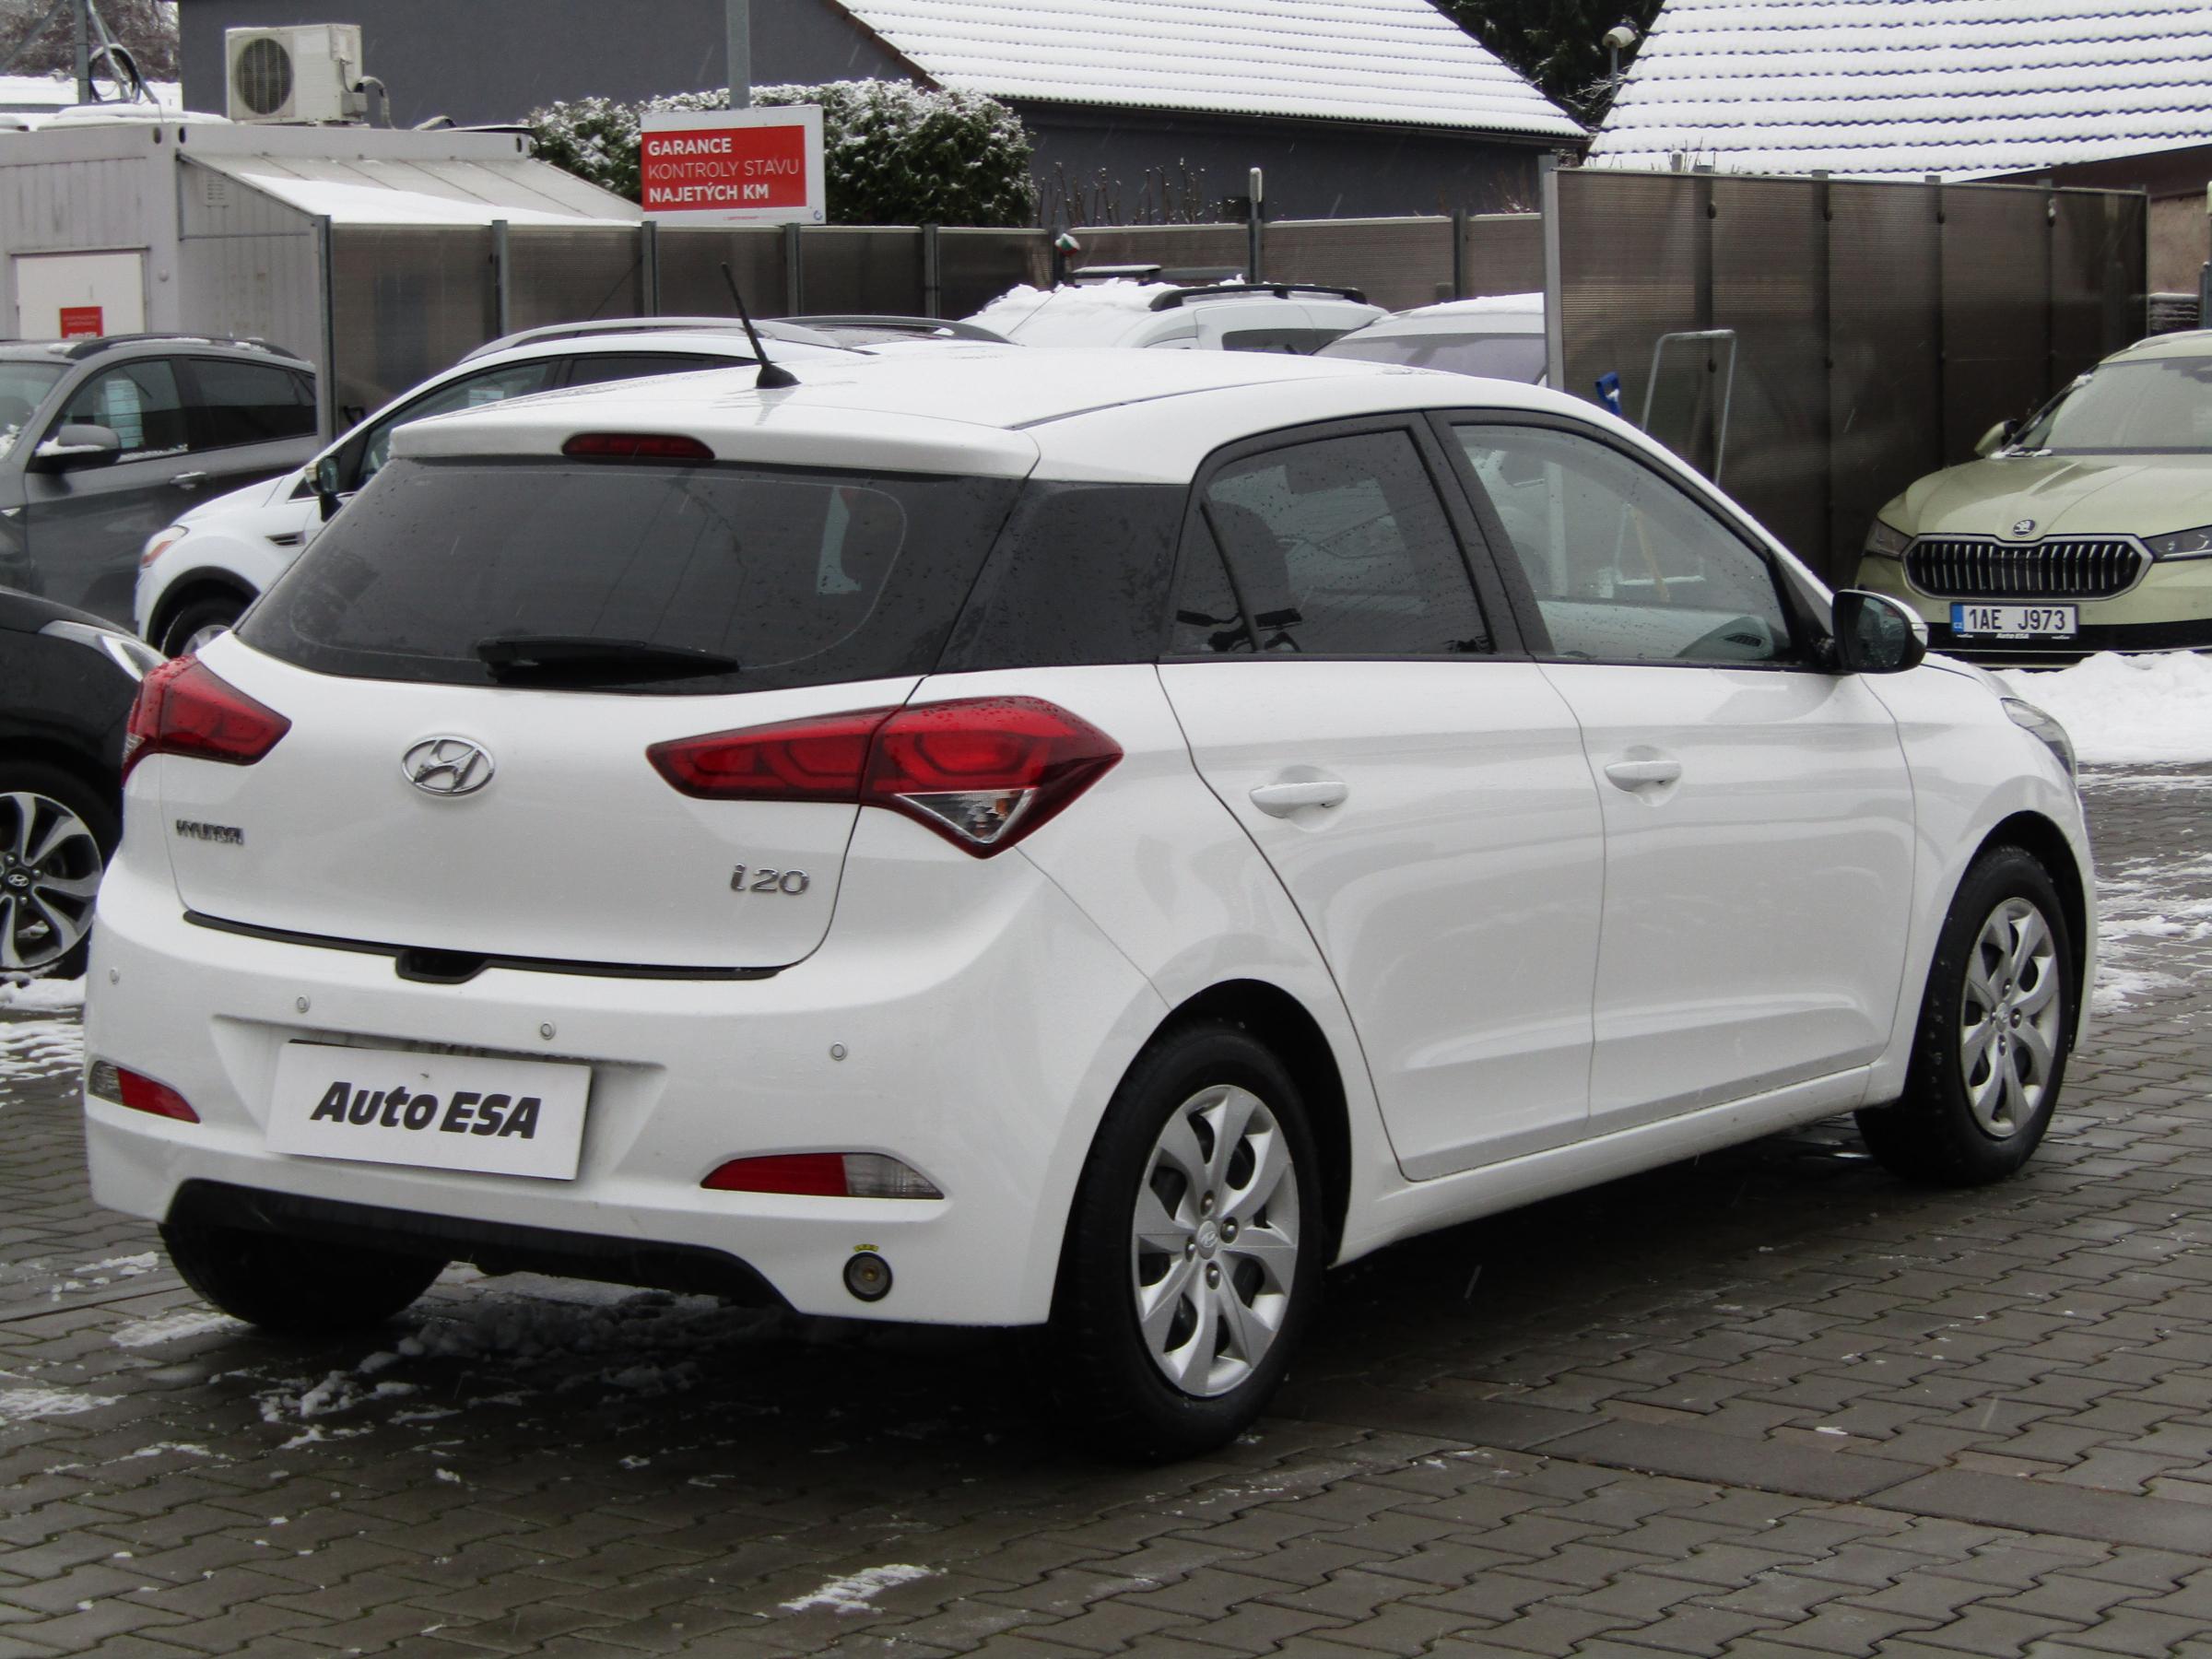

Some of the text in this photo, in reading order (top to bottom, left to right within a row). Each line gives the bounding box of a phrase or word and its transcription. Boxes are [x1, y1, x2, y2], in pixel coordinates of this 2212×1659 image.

[648, 137, 733, 157] GARANCE
[648, 159, 800, 180] KONTROLY STAVU
[649, 182, 770, 203] NAJETÝCH KM
[1969, 608, 2066, 630] 1AE J973
[730, 863, 810, 896] i20
[310, 1081, 542, 1140] Auto ESA
